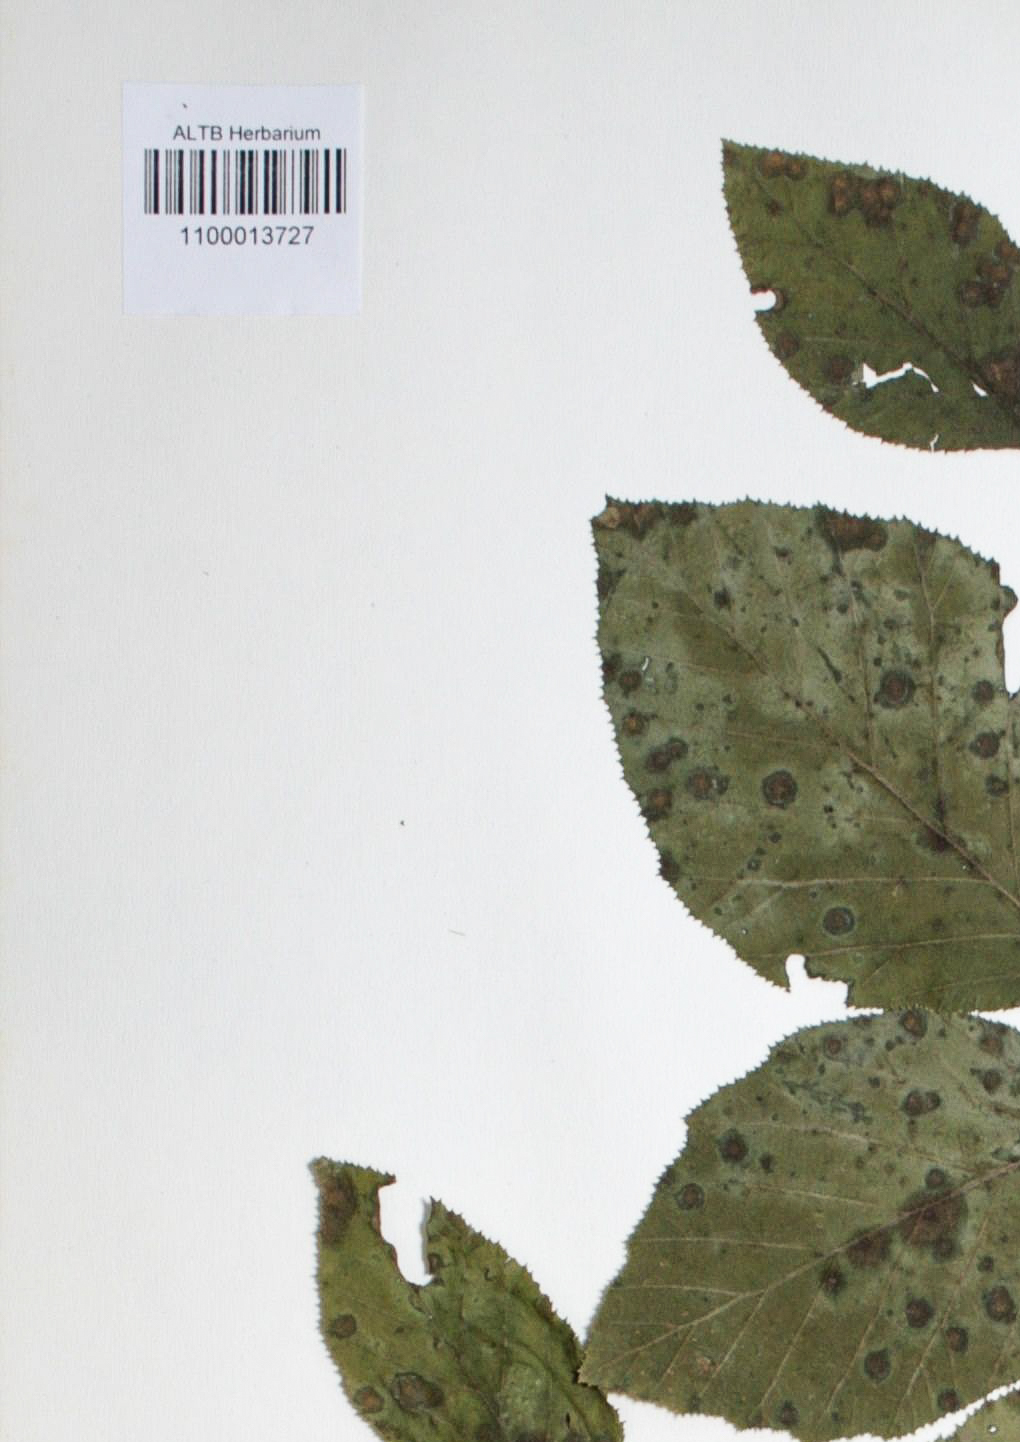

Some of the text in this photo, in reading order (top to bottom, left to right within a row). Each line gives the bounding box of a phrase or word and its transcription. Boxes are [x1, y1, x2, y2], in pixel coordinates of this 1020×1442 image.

[172, 124, 321, 142] ALTB Herbarium
[180, 225, 315, 246] 1100013727
